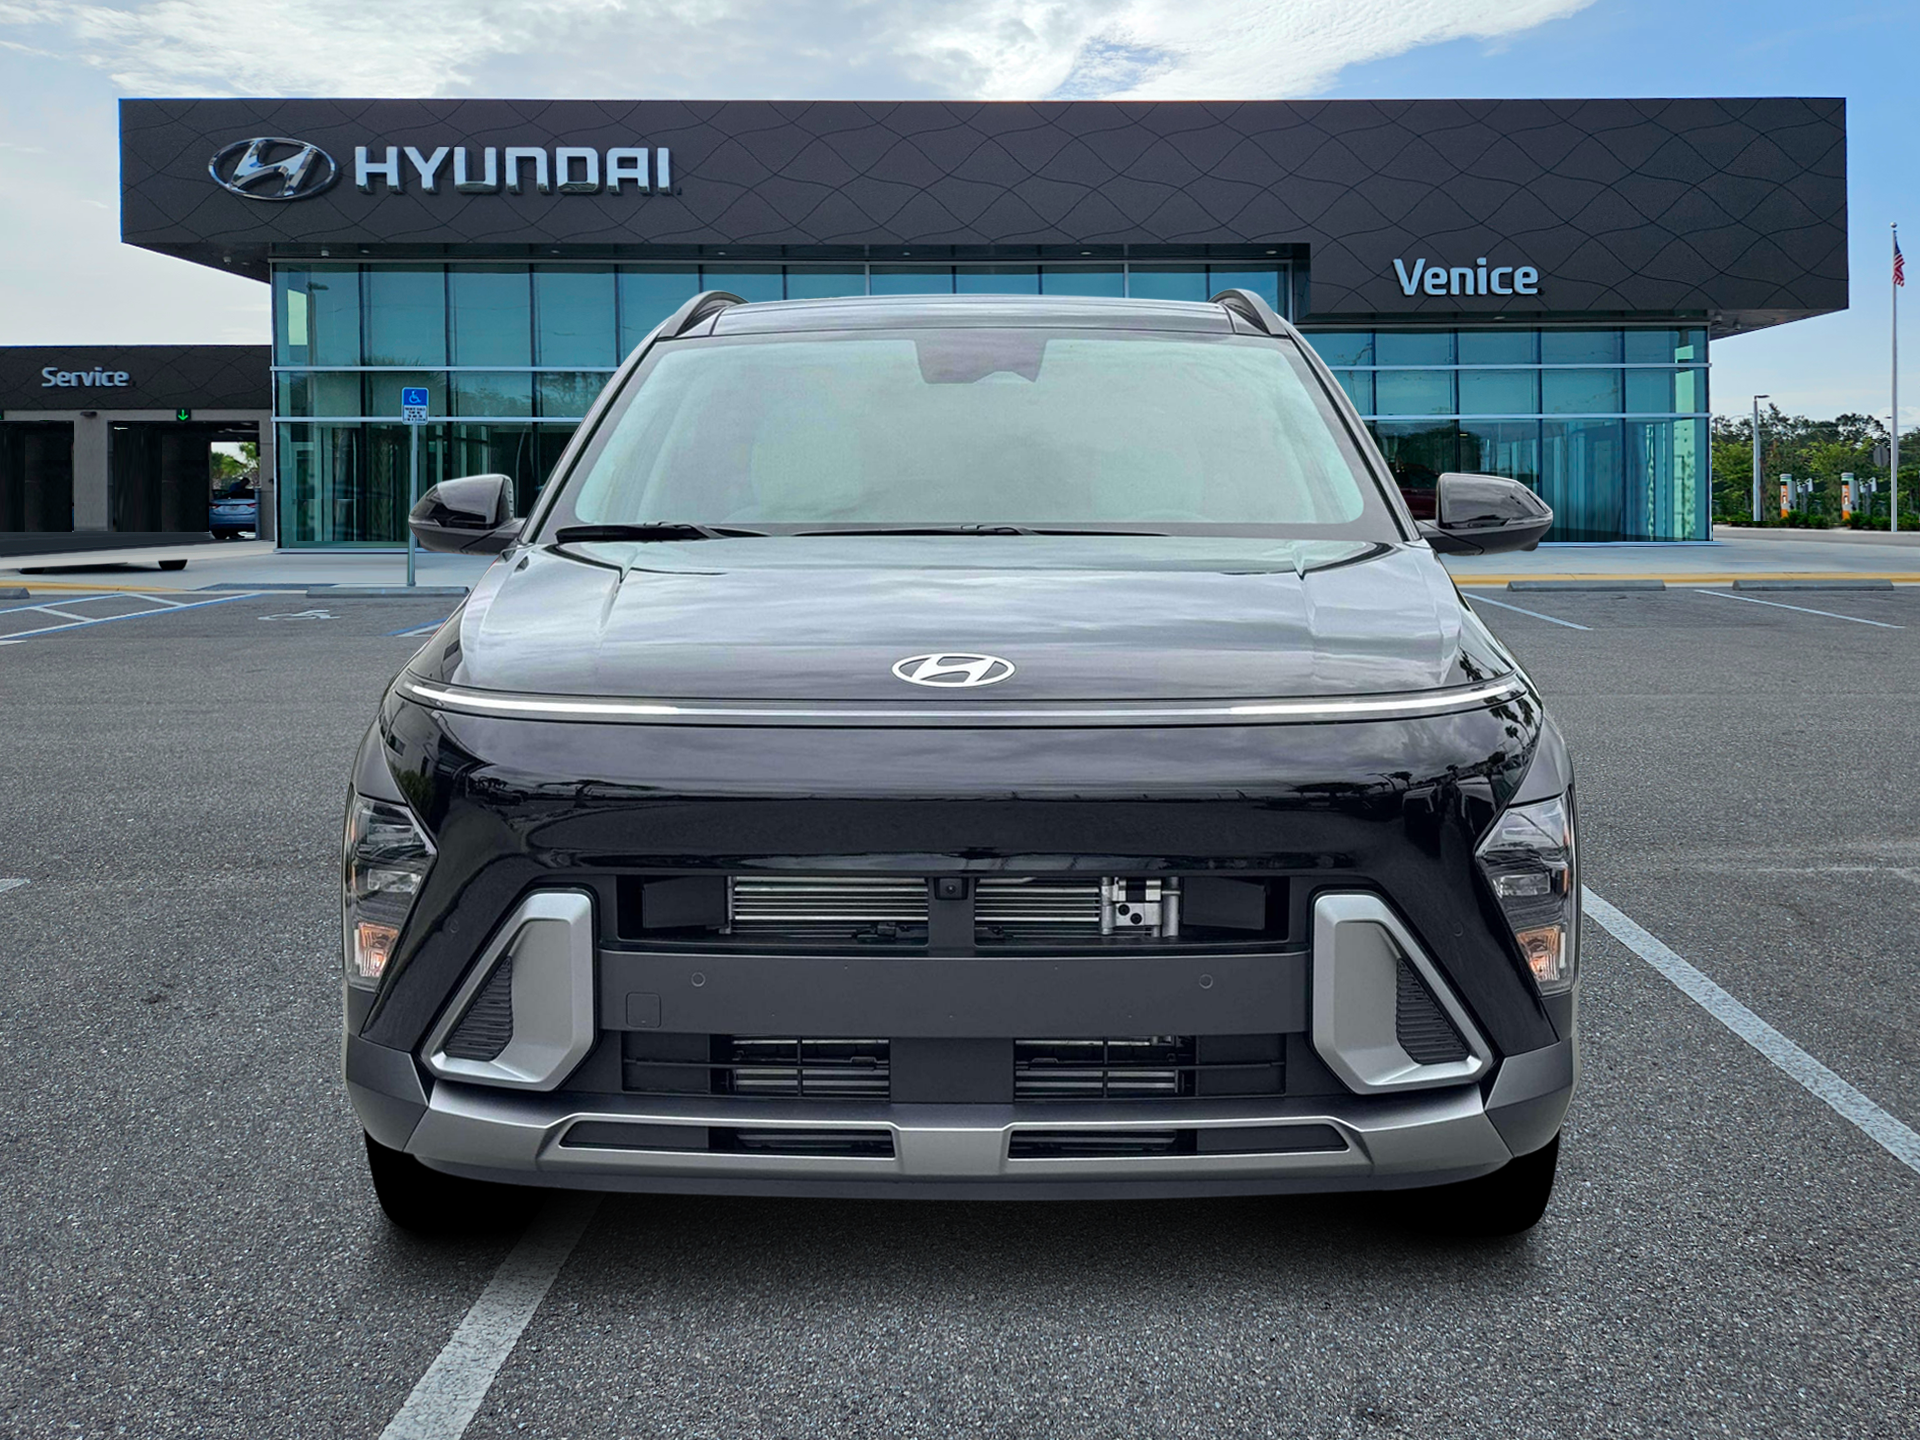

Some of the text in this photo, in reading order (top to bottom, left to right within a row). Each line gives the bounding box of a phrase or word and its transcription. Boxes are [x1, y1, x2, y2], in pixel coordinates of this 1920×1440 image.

[354, 146, 671, 194] HYUNDAI
[1393, 257, 1539, 296] Venice
[41, 366, 130, 387] Service
